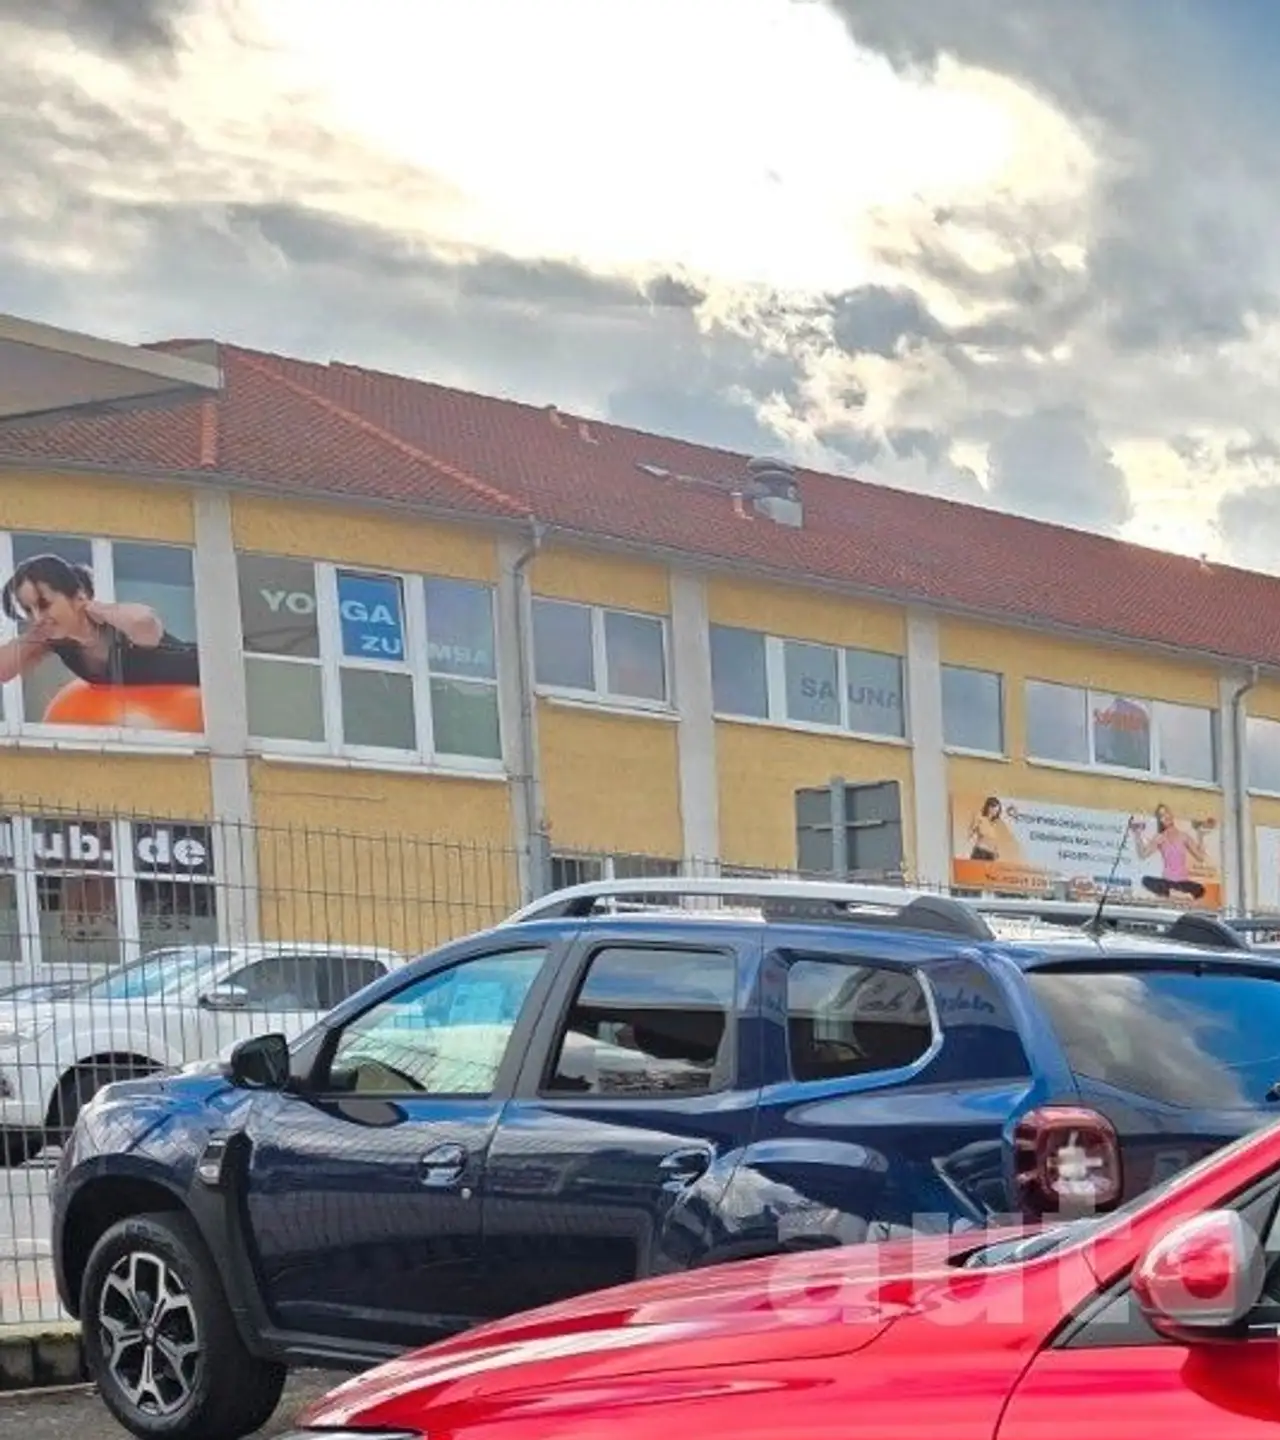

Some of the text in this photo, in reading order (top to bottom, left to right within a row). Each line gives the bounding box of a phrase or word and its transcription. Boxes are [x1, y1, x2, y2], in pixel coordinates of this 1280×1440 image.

[261, 588, 396, 626] YOGA
[361, 634, 490, 665] ZUMBA
[801, 678, 899, 709] SAUNA
